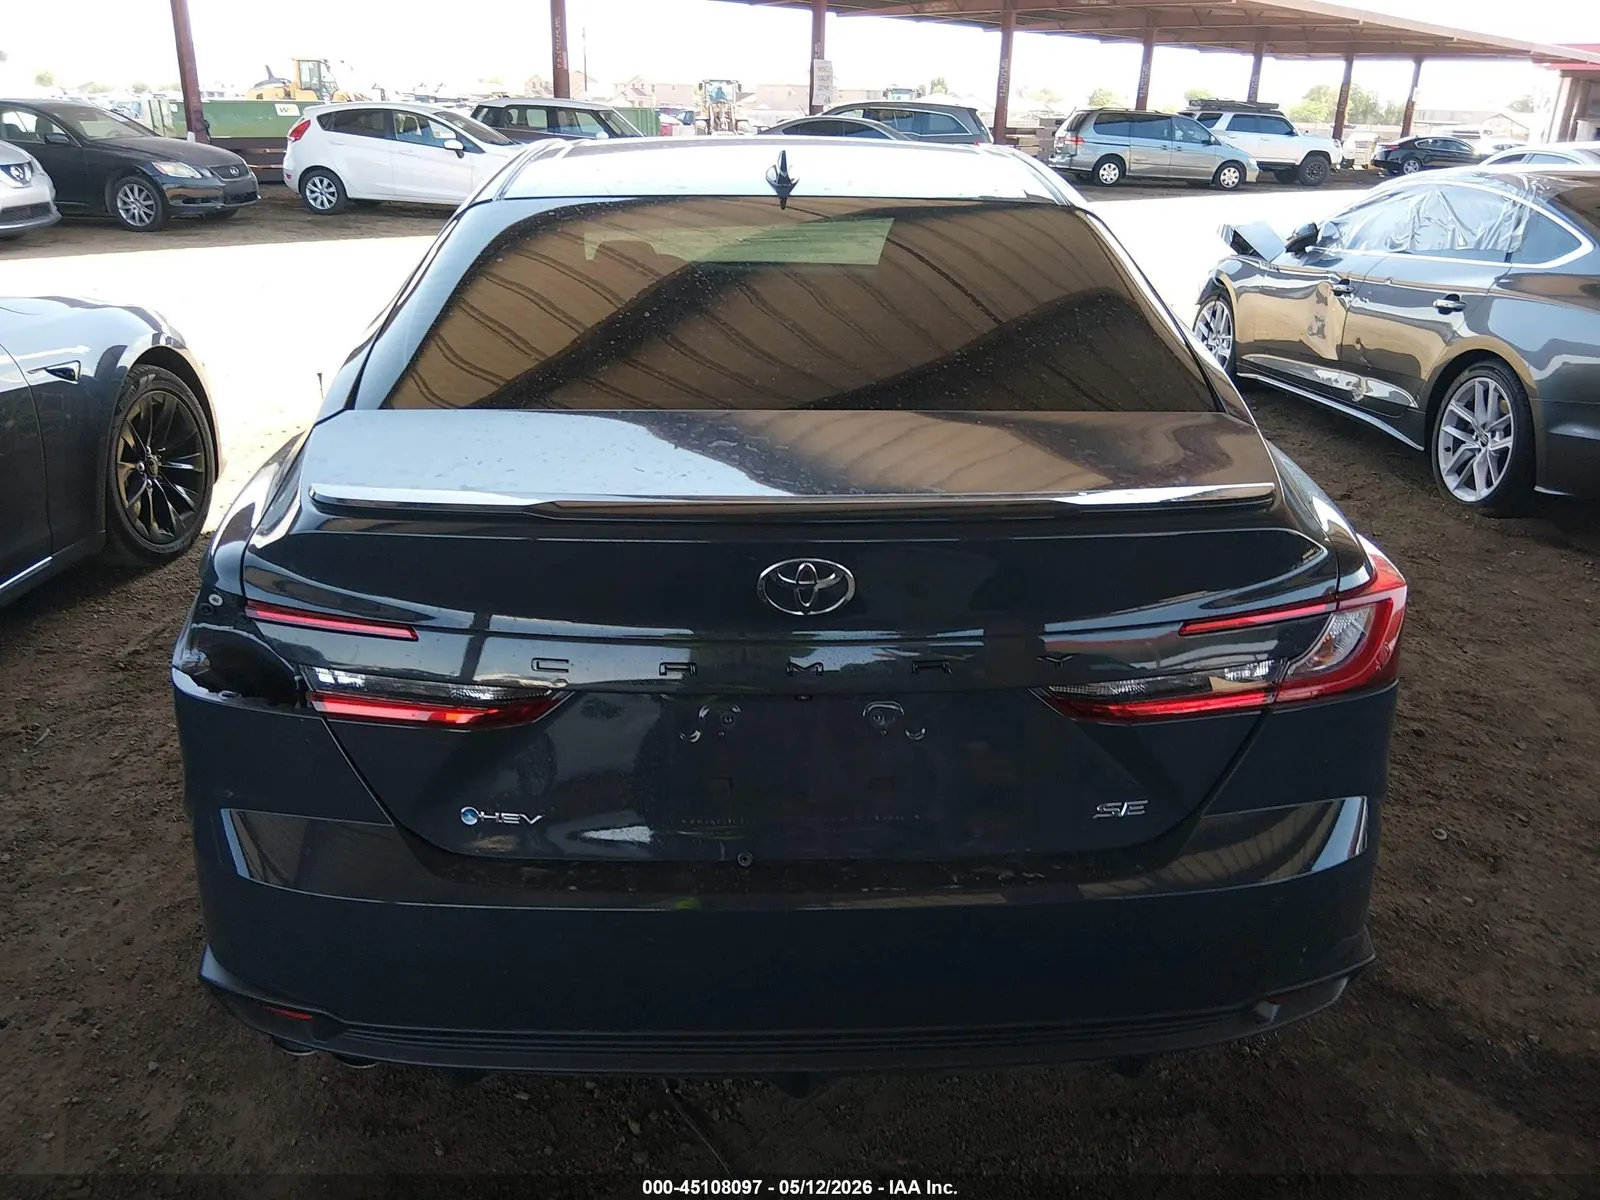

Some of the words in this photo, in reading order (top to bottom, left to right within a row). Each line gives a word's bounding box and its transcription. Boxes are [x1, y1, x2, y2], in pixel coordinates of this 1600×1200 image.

[531, 655, 1074, 677] CAMRY
[480, 811, 545, 825] HEV
[1092, 799, 1149, 819] SE
